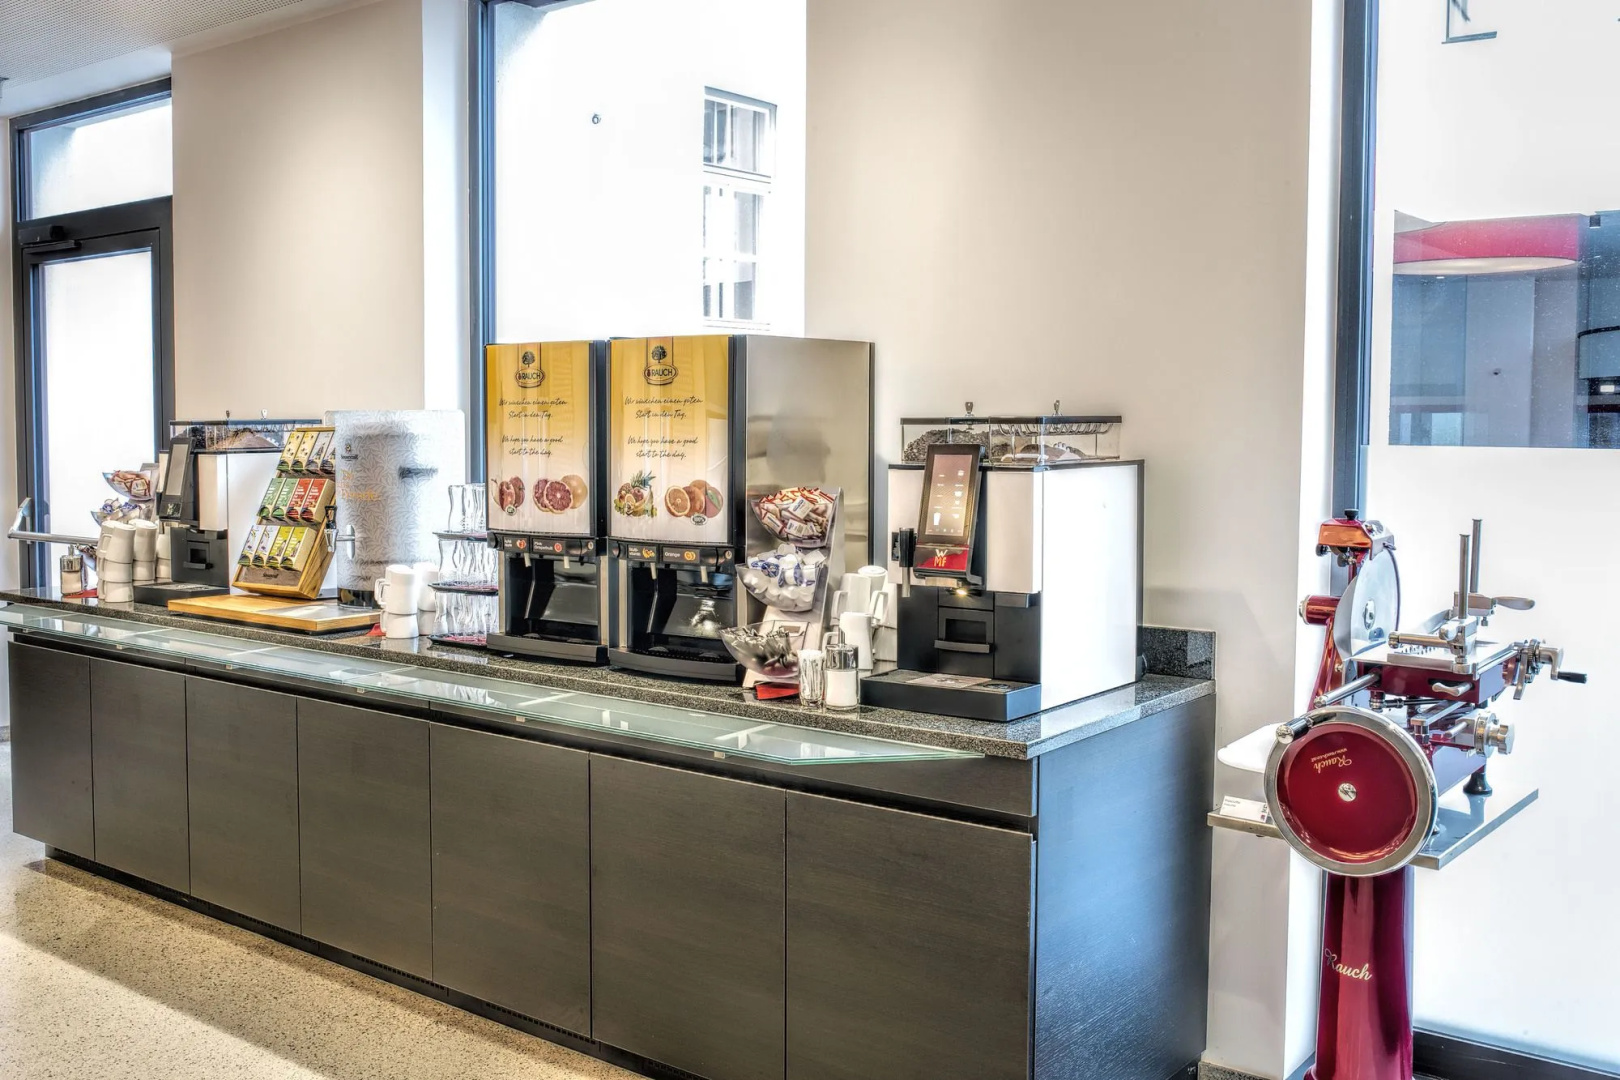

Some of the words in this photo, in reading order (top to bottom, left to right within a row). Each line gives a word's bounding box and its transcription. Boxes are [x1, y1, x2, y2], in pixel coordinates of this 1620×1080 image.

[521, 372, 541, 380] RAUCH
[651, 368, 673, 377] RAUCH
[624, 396, 635, 406] Wir
[681, 395, 703, 407] guten
[508, 410, 522, 419] Start
[635, 409, 651, 419] Start
[530, 435, 544, 443] have
[627, 435, 637, 445] We
[637, 436, 650, 447] hope
[660, 436, 675, 444] have
[682, 436, 699, 447] good
[659, 449, 671, 458] the
[1313, 755, 1352, 774] Rauch
[1324, 948, 1373, 981] Rauch
